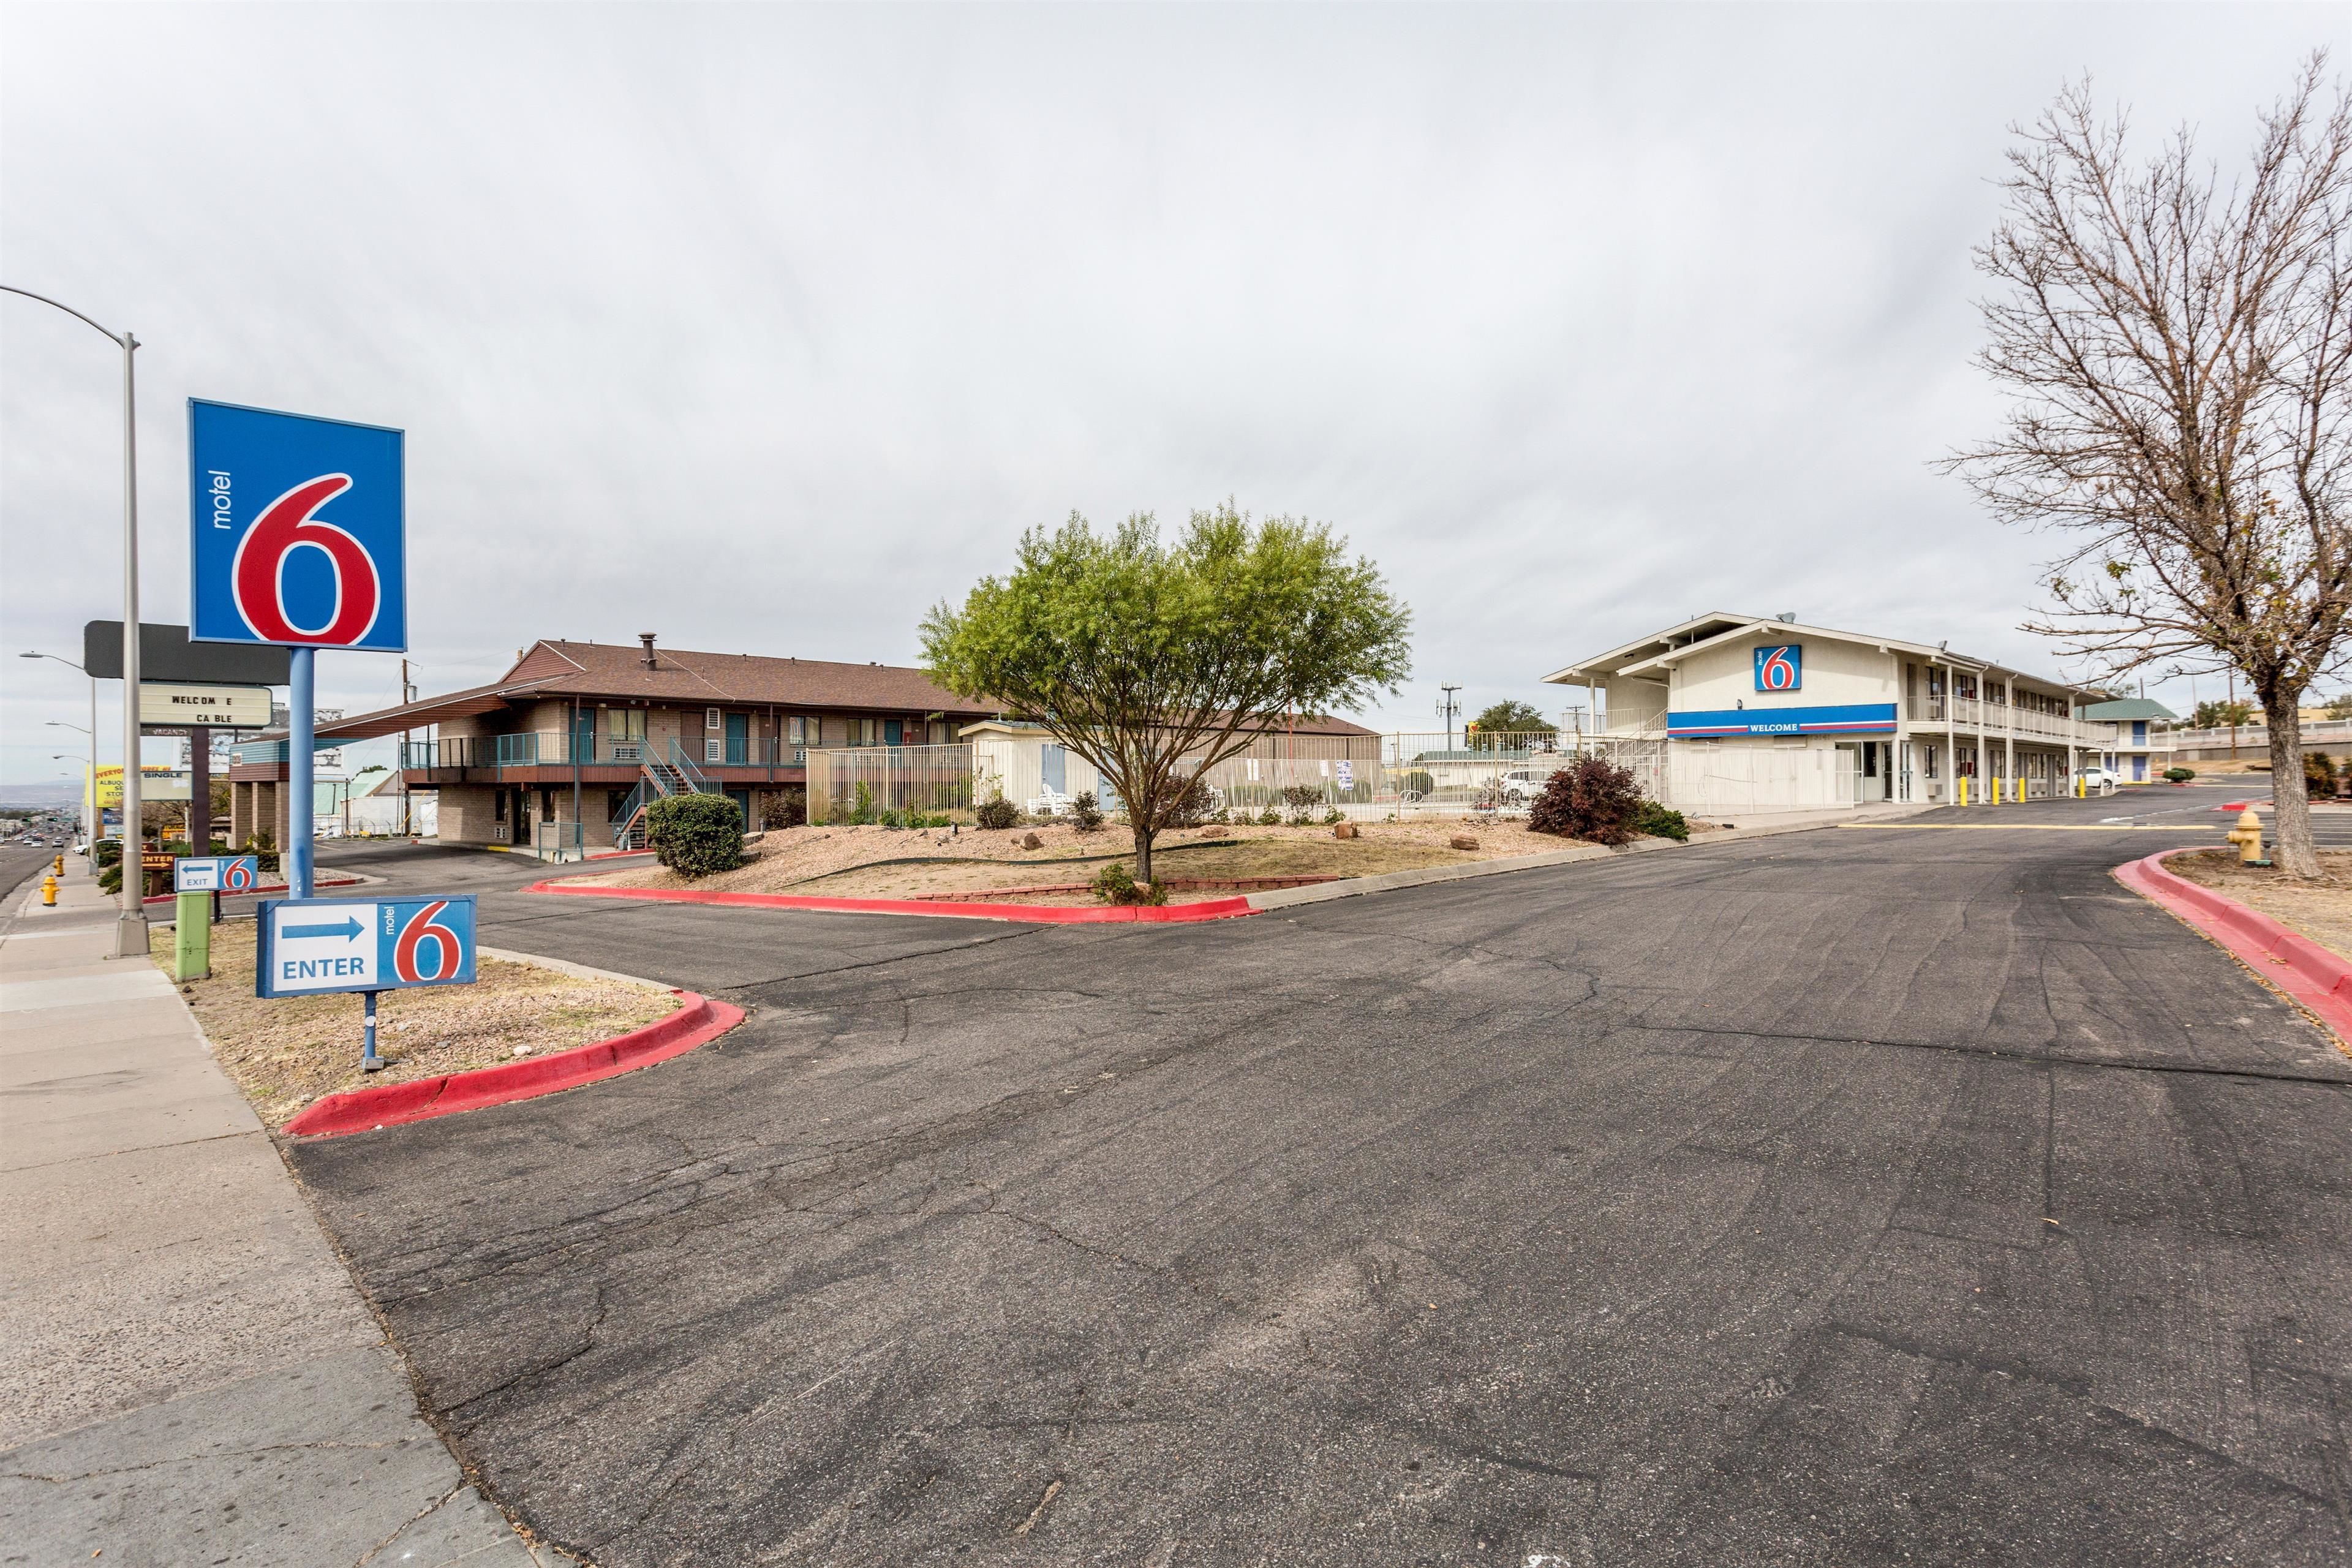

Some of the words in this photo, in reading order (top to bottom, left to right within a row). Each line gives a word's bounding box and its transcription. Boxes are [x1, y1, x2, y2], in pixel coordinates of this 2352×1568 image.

[208, 470, 231, 529] motel
[232, 472, 381, 646] 6
[1762, 646, 1795, 689] 6
[224, 858, 252, 888] 6
[384, 907, 394, 935] motel
[394, 901, 462, 982] 6
[284, 957, 364, 979] ENTER
